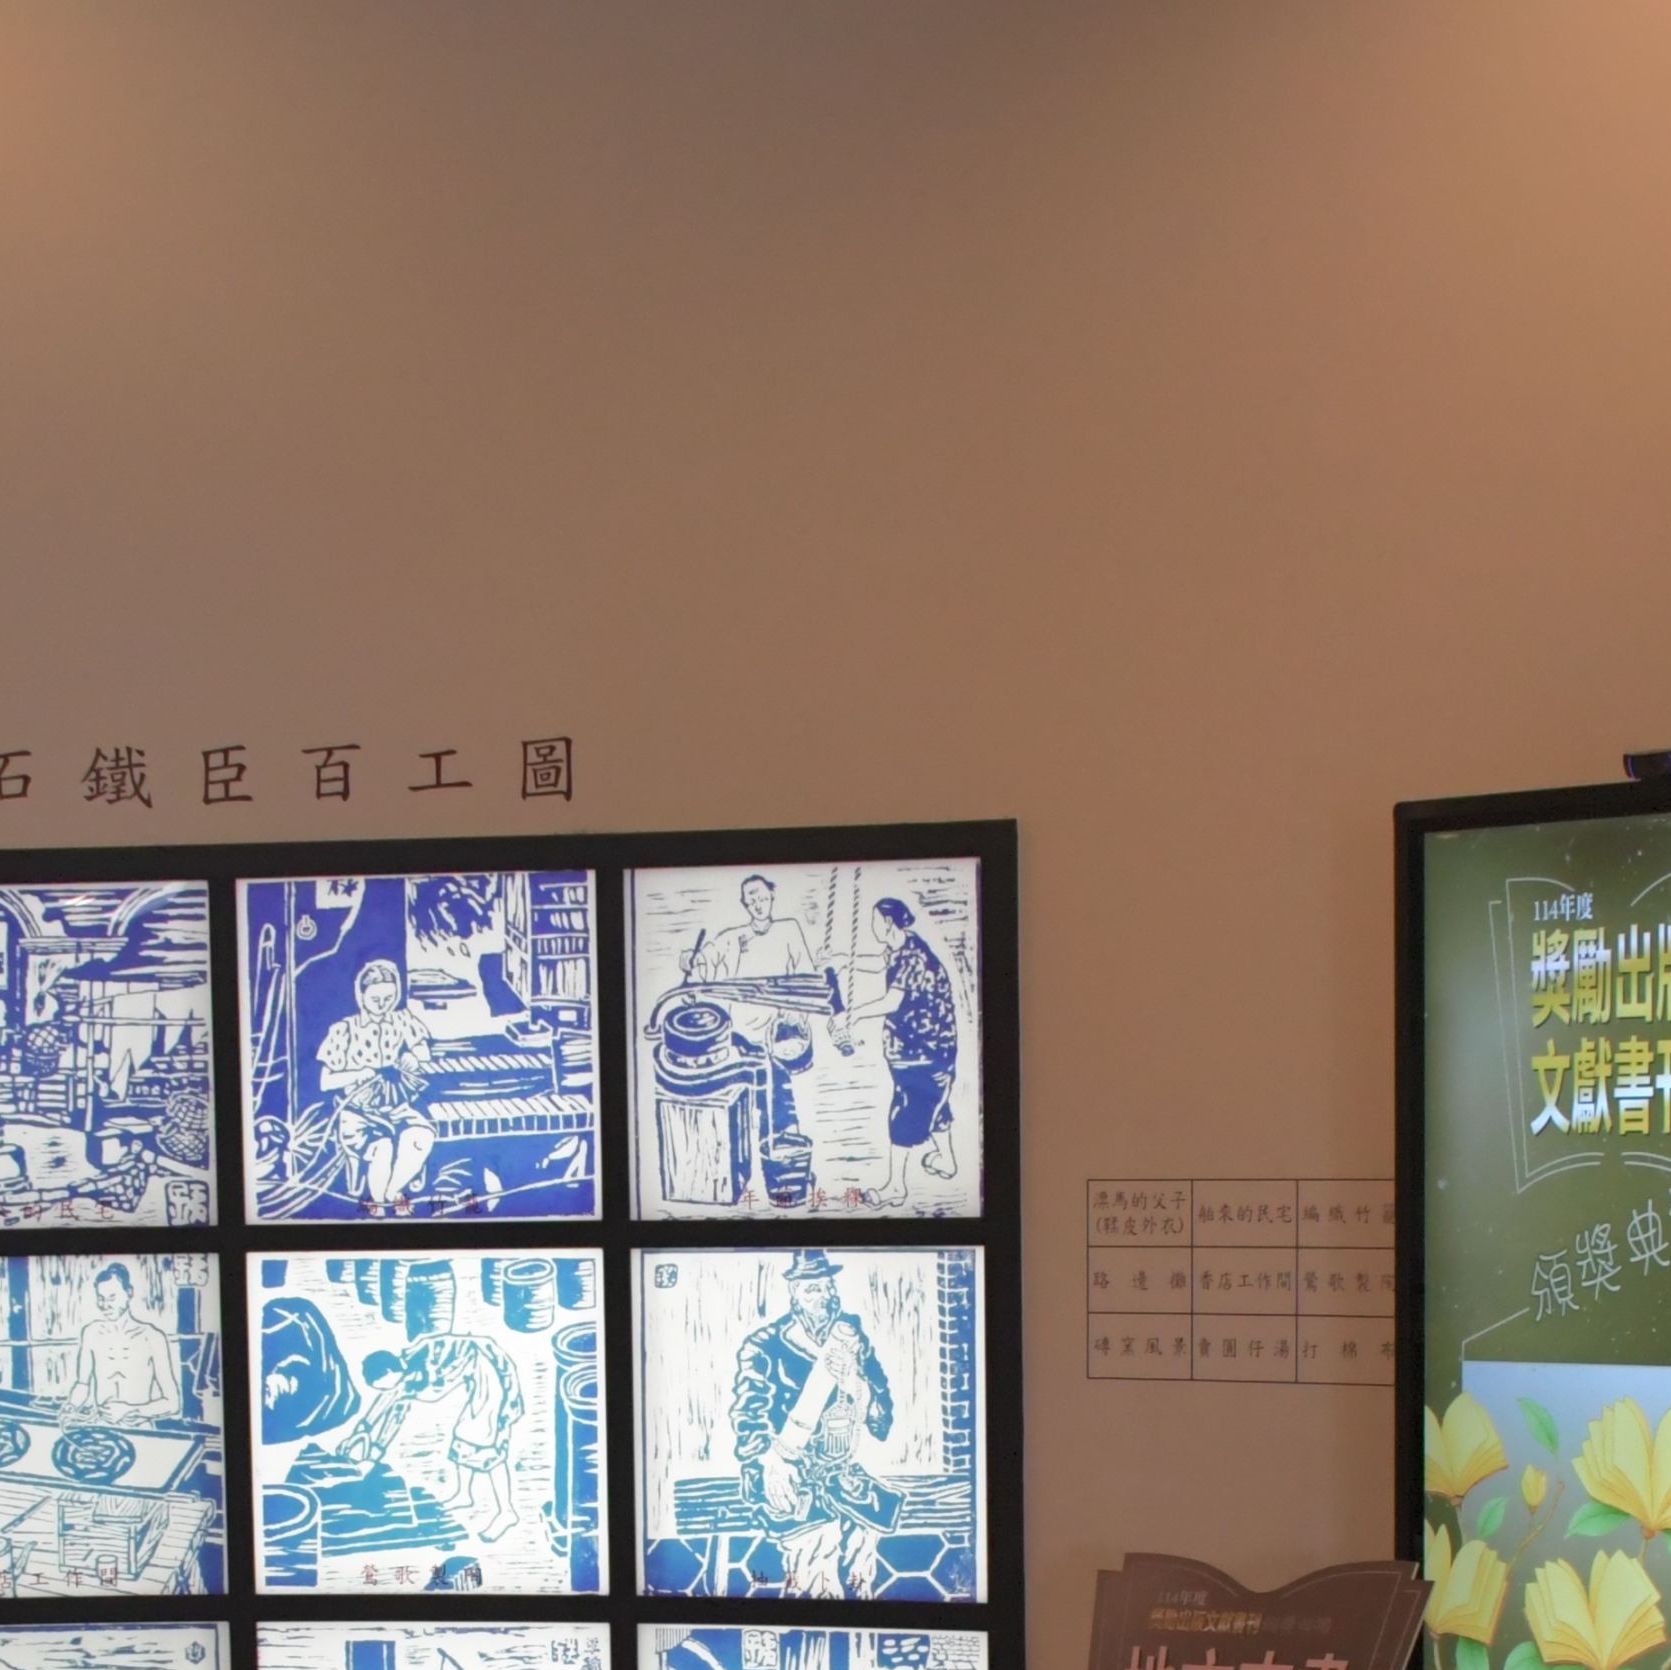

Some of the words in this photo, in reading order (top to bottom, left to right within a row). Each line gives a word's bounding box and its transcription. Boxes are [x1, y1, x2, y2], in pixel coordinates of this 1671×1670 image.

[1532, 892, 1593, 923] 114年度
[1199, 1270, 1292, 1292] 香店工作間
